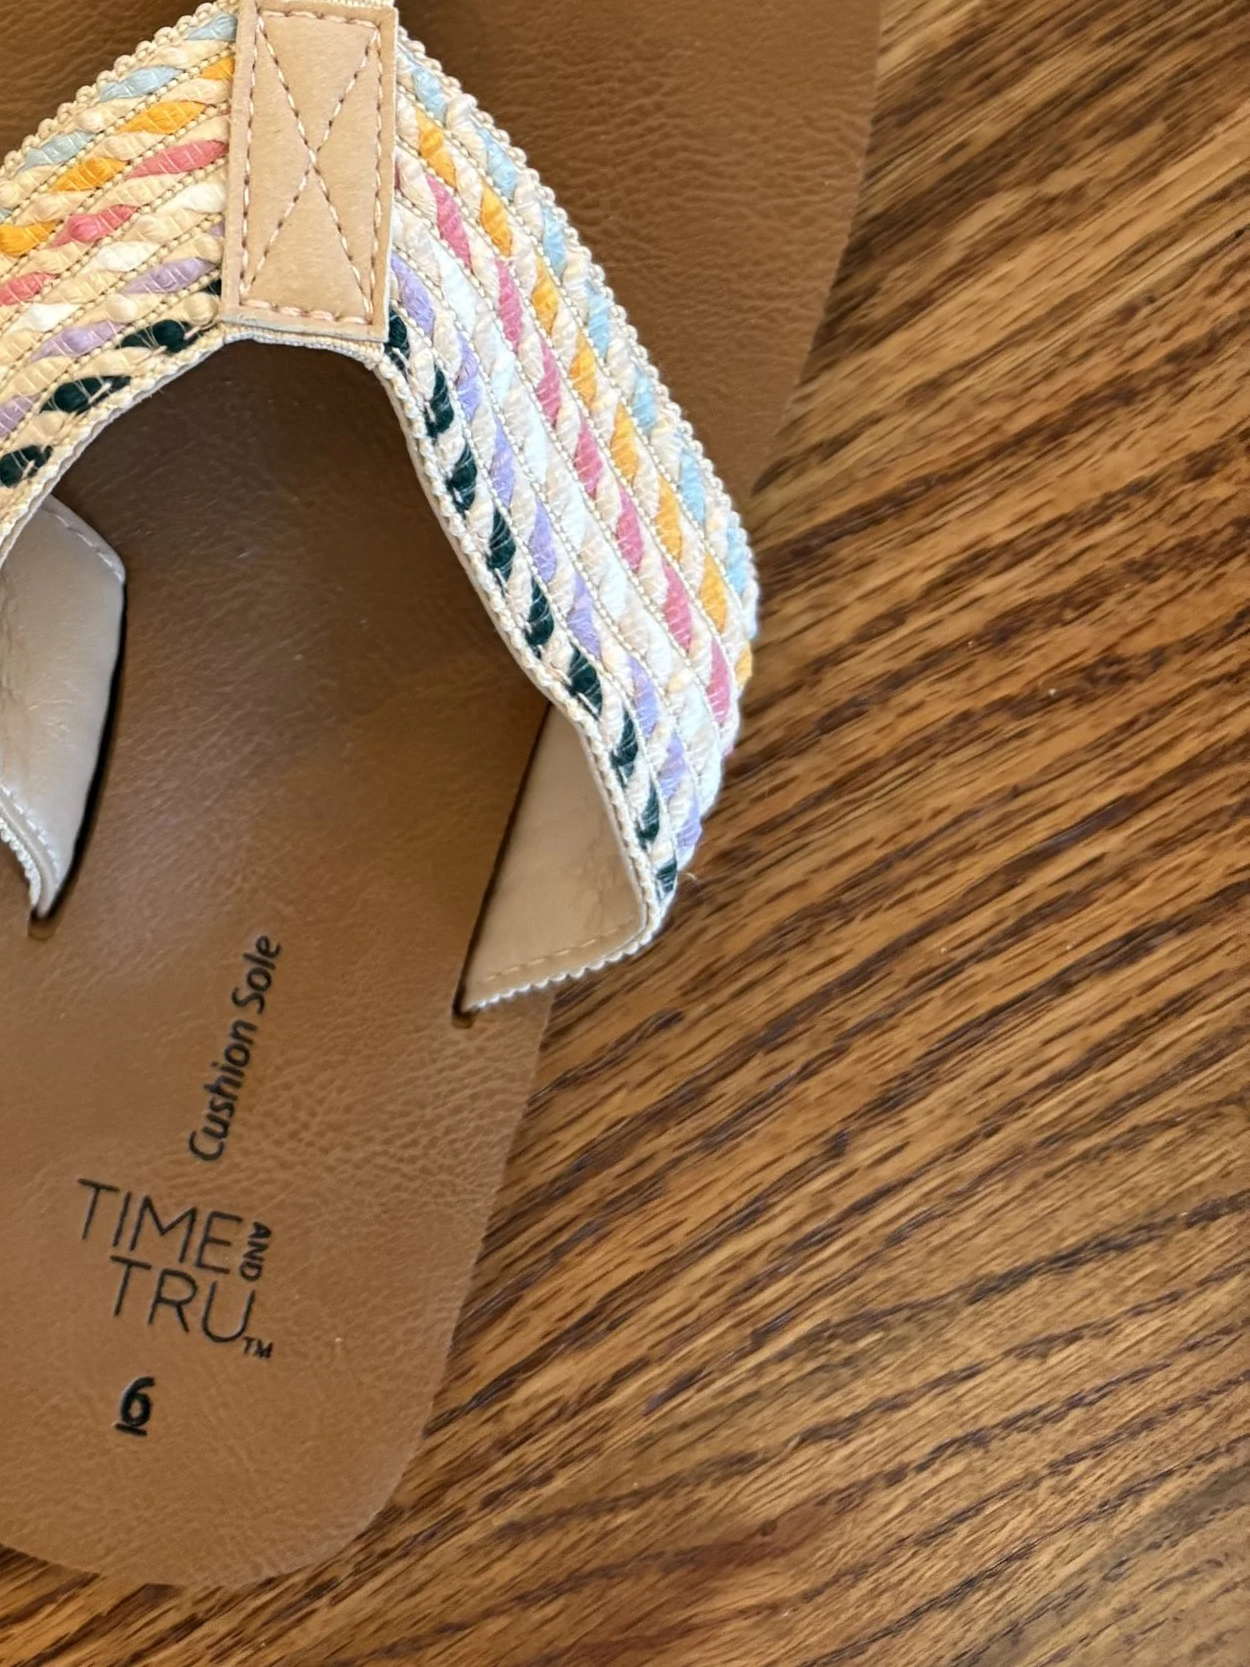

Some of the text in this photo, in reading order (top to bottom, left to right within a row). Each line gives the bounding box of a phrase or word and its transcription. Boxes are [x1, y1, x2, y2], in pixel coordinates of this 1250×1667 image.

[188, 935, 282, 1162] Cushion Sole
[77, 1177, 272, 1282] TIME AND
[109, 1254, 256, 1343] TRU
[116, 1376, 155, 1430] 6
